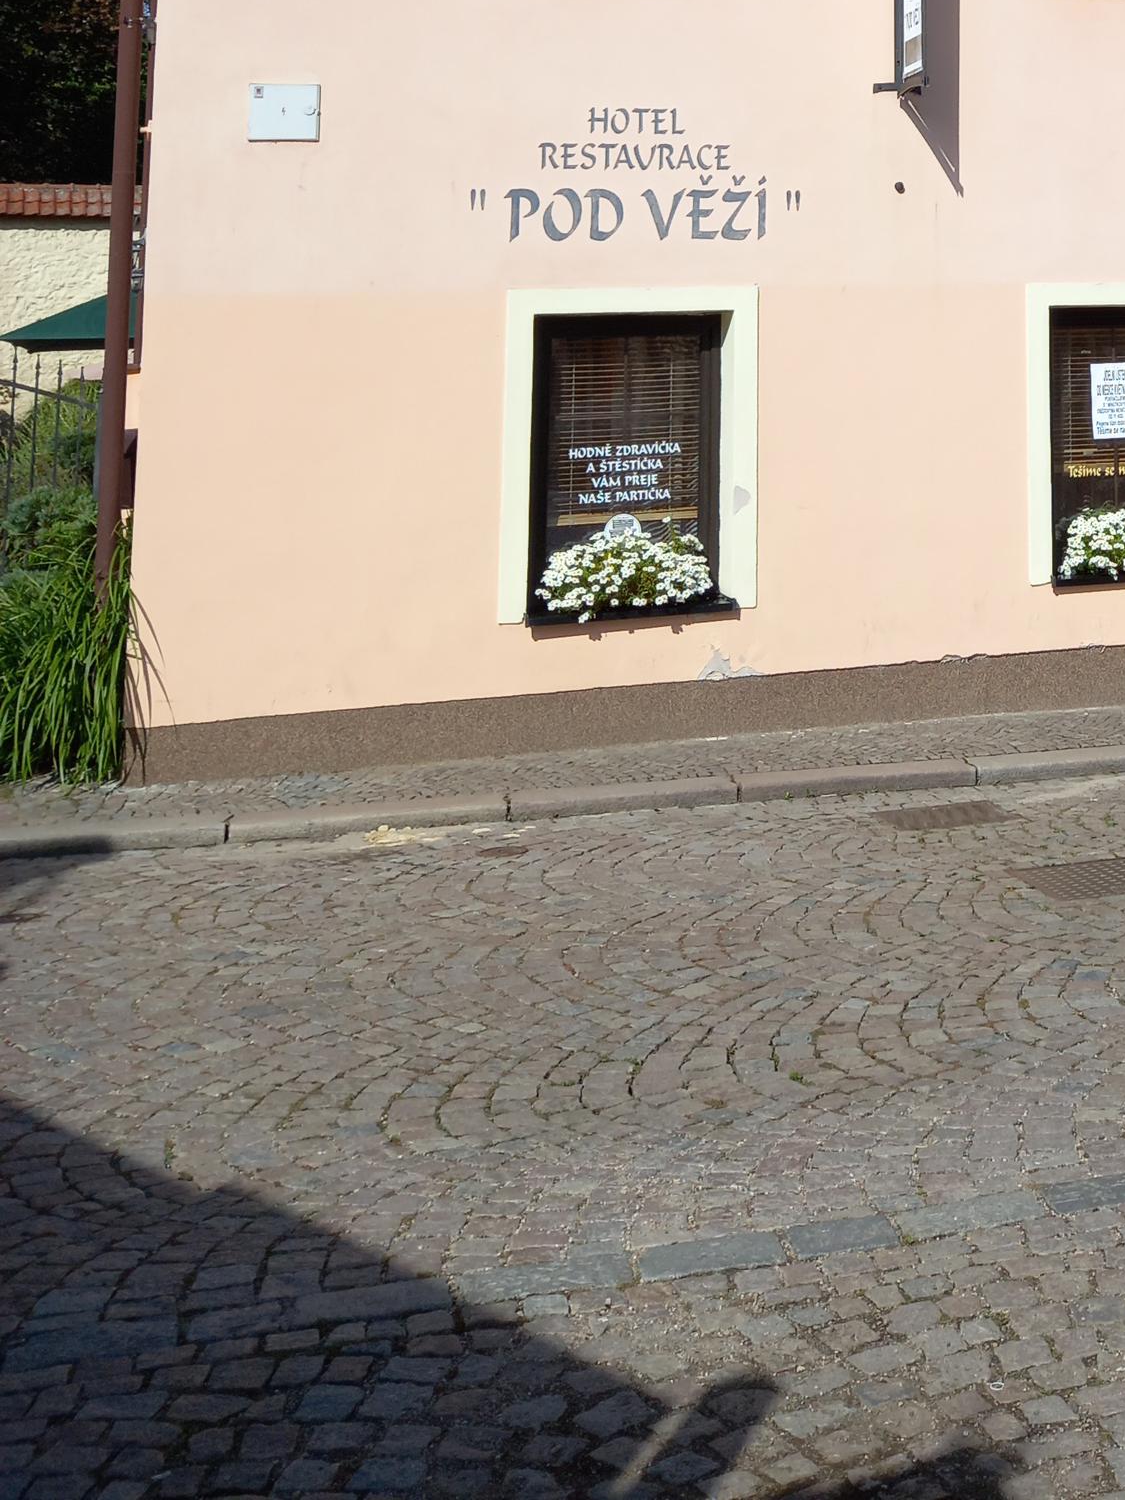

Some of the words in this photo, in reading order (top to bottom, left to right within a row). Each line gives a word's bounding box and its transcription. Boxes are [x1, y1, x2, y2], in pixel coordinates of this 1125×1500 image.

[587, 107, 685, 134] HOTEL
[568, 444, 612, 459] HODNĚ
[615, 441, 681, 456] ZDRAVÍČKA
[586, 462, 596, 473] A
[599, 457, 664, 472] ŠTĚSTÍČKA
[1104, 466, 1115, 476] se
[591, 474, 620, 488] VÁM
[624, 472, 659, 486] PŘEJE
[578, 490, 612, 504] NAŠE
[615, 487, 671, 502] PARTIČKA
